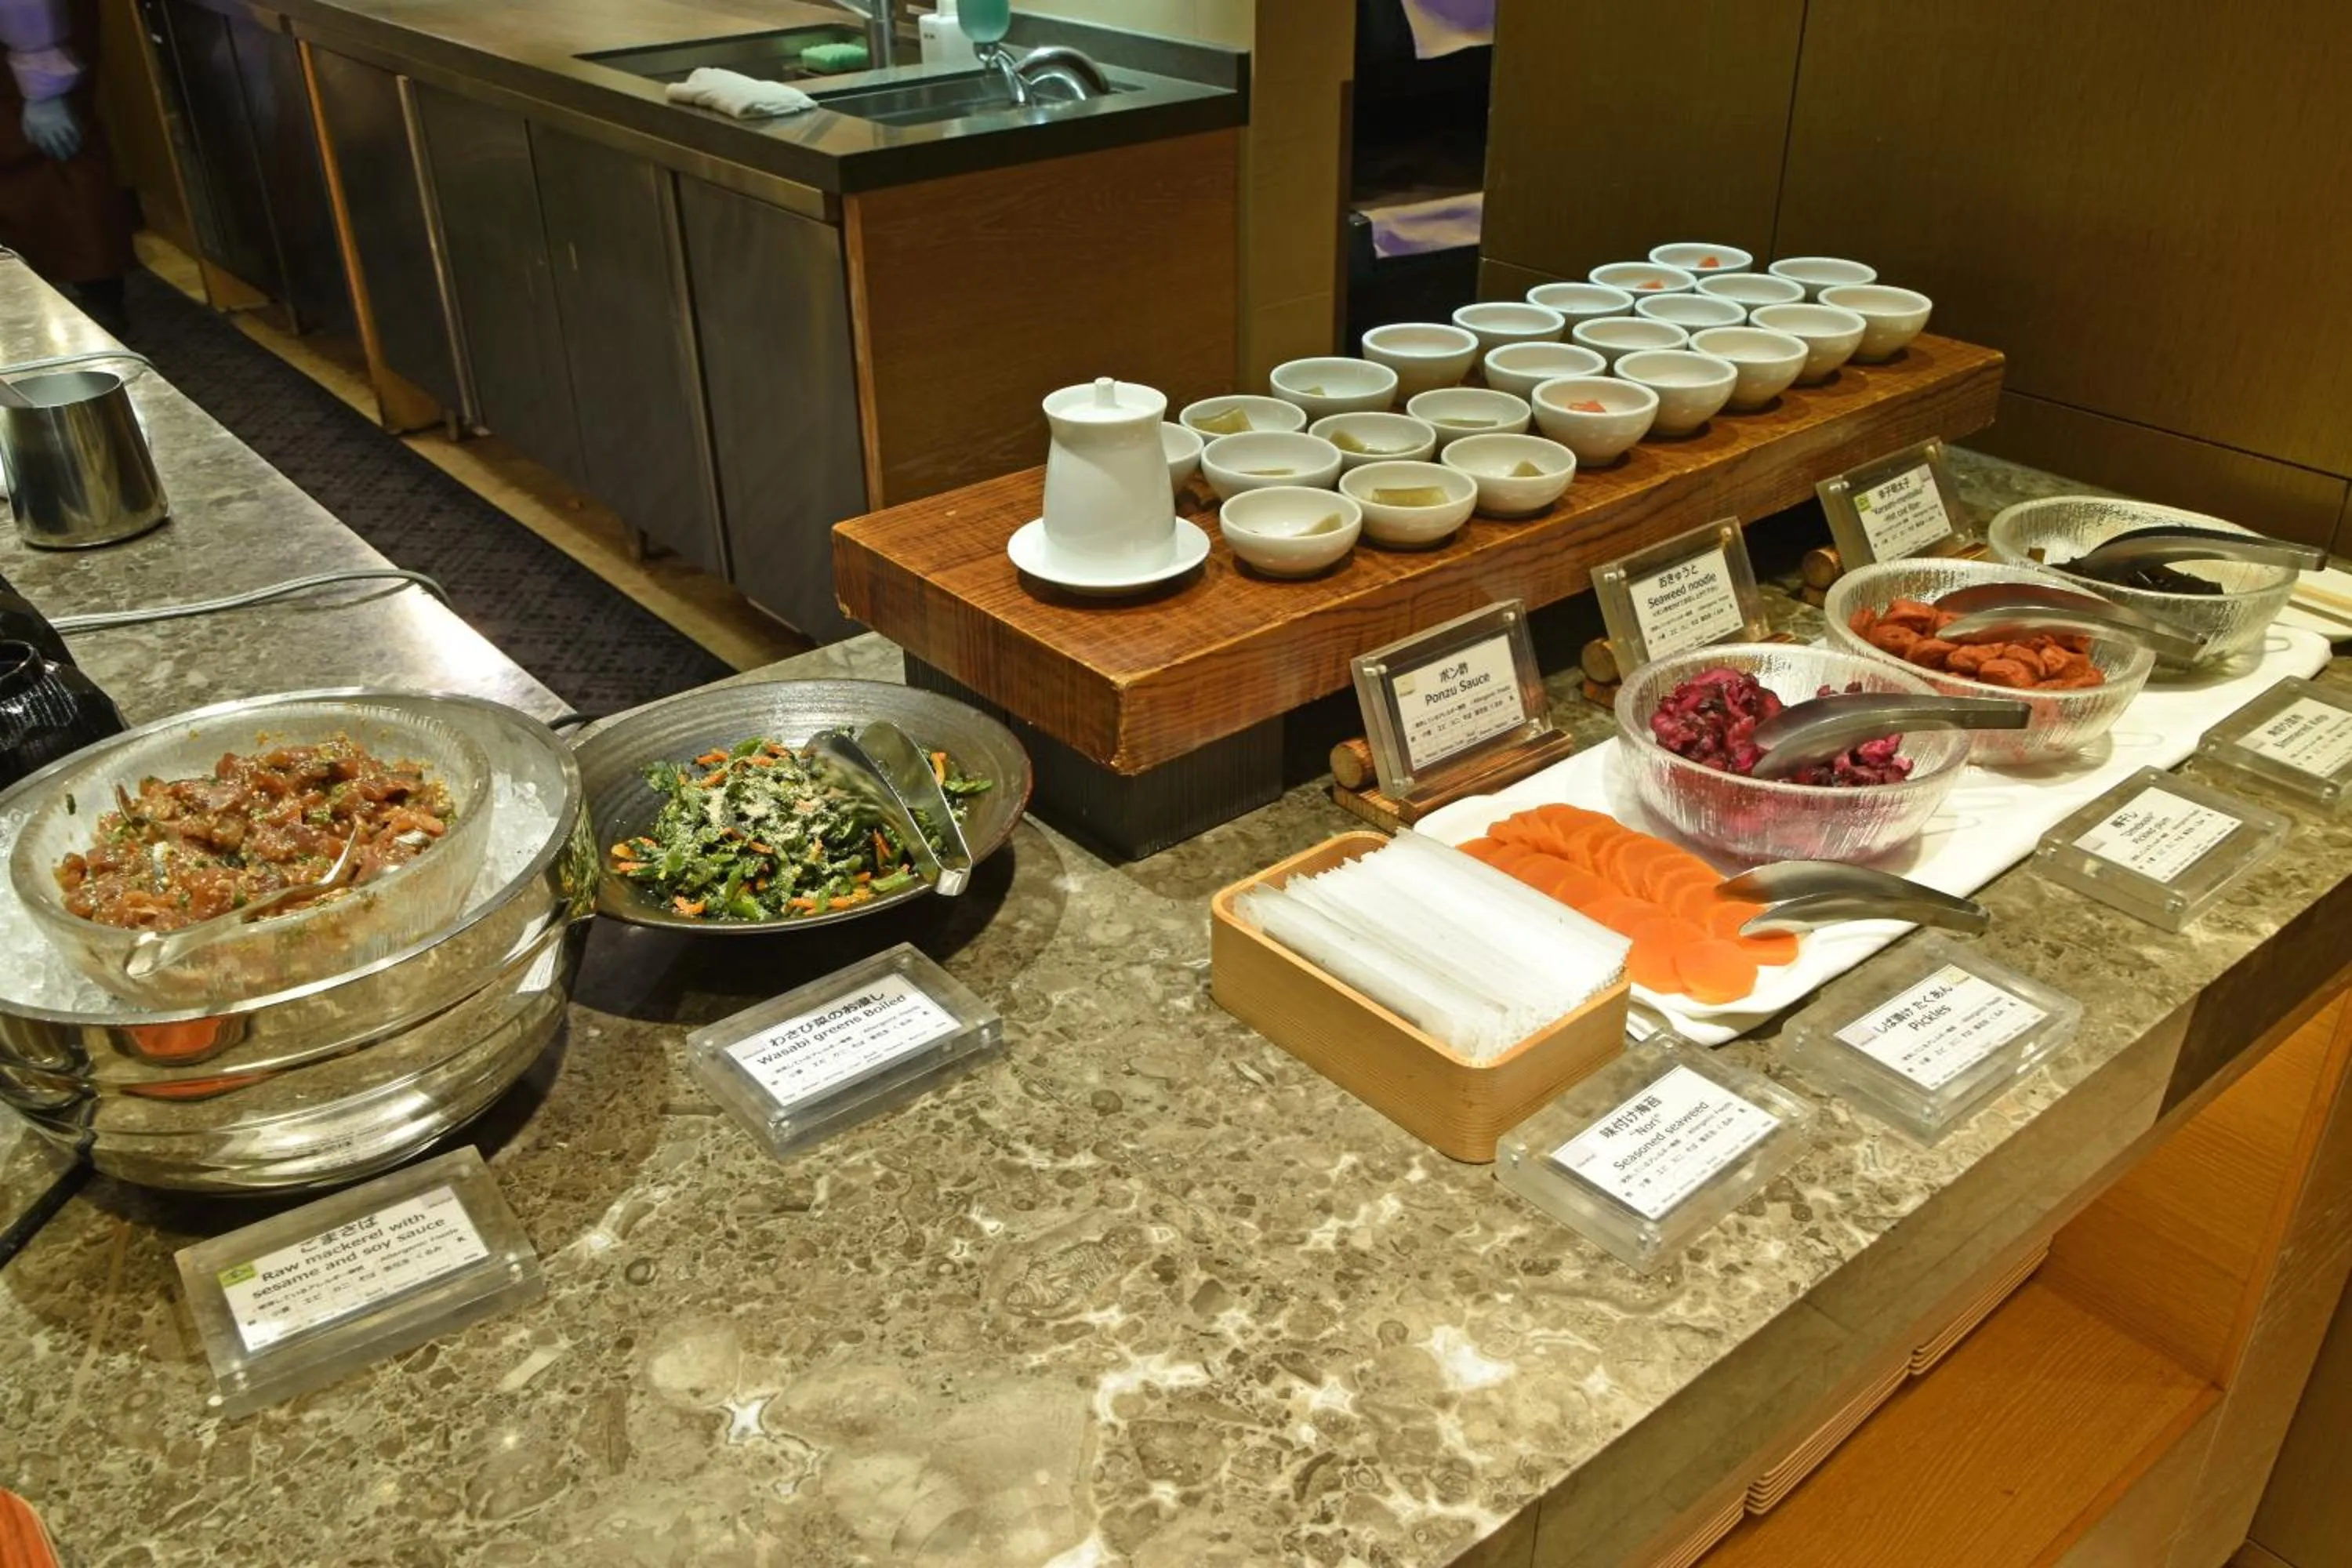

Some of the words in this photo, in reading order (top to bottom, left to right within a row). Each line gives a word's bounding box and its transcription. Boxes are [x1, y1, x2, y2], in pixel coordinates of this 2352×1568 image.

[1648, 584, 1686, 608] Seaweed
[1688, 573, 1717, 590] noodle
[1658, 564, 1699, 588] おきゅうと
[1425, 685, 1457, 706] Ponzu
[1459, 673, 1490, 692] Sauce
[1911, 985, 1953, 1011] たくあん
[757, 1037, 811, 1065] Wasabi
[813, 1016, 862, 1042] greens
[862, 994, 906, 1018] Boiled
[1907, 1004, 1951, 1031] Pickles
[1599, 1094, 1663, 1138] 味付け海苔
[1613, 1131, 1667, 1171] Seasoned
[1664, 1102, 1710, 1134] seaweed
[261, 1262, 299, 1283] Raw
[304, 1229, 383, 1265] mackerel
[389, 1214, 426, 1232] with
[300, 1216, 378, 1253] ごまさば
[252, 1268, 320, 1299] sesame
[325, 1252, 358, 1271] and
[363, 1239, 391, 1255] soy
[397, 1218, 445, 1242] sauce
